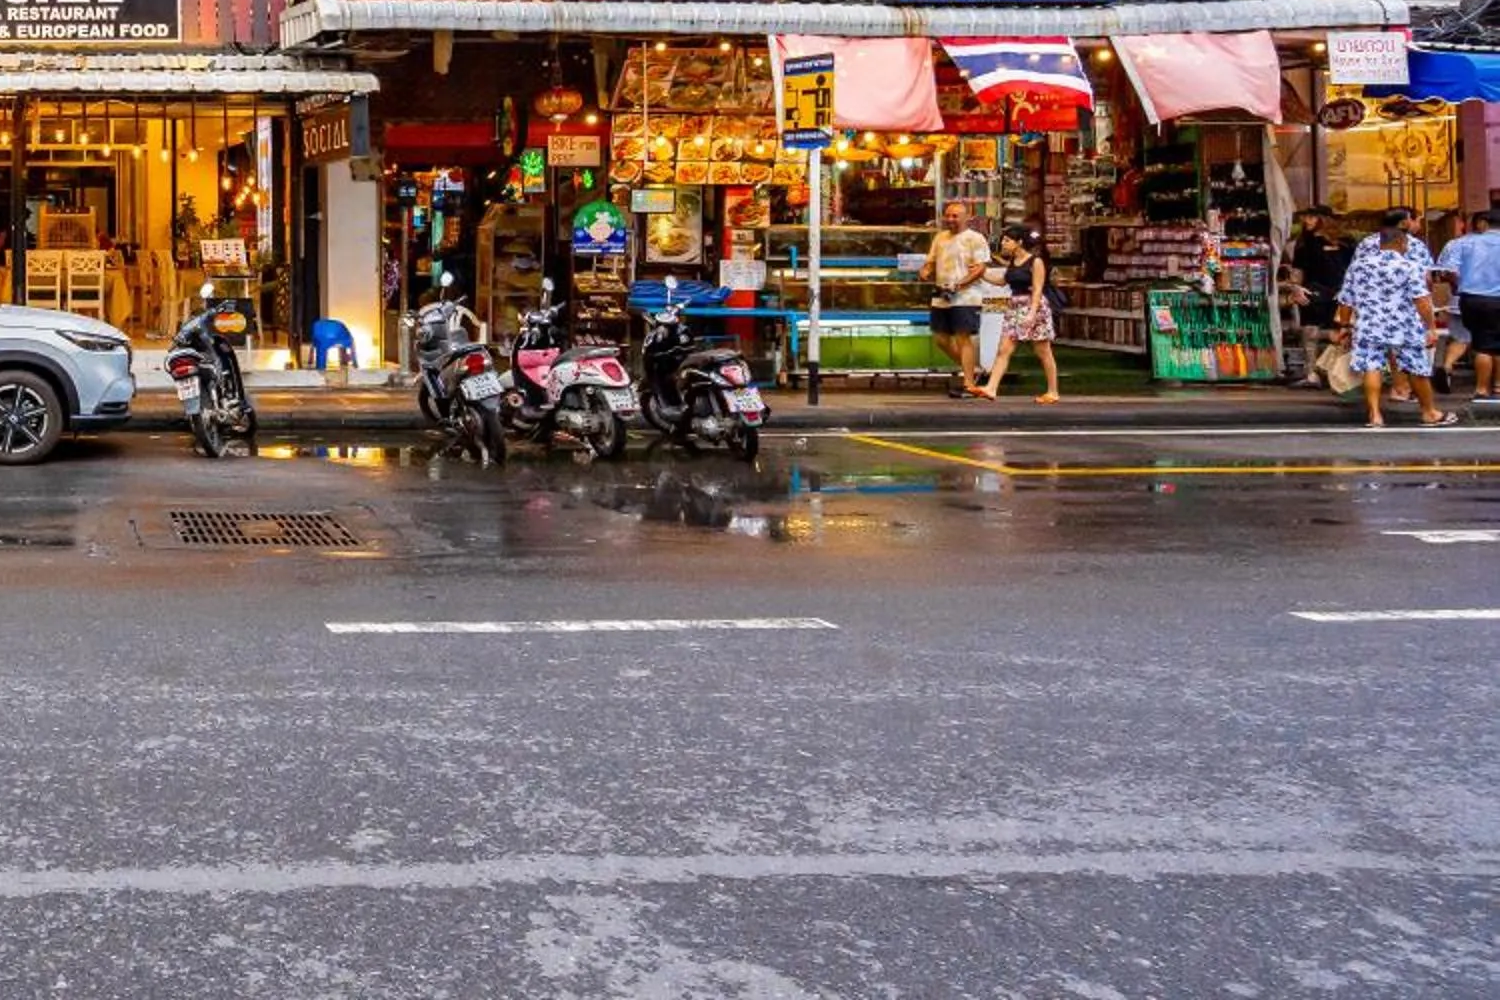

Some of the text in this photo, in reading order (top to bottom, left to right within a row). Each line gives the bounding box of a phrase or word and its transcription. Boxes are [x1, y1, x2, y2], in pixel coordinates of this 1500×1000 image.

[7, 6, 120, 21] RESTAURANT
[16, 23, 115, 38] EUROPEAN
[119, 23, 170, 37] FOOD
[303, 119, 349, 158] SOCIAL
